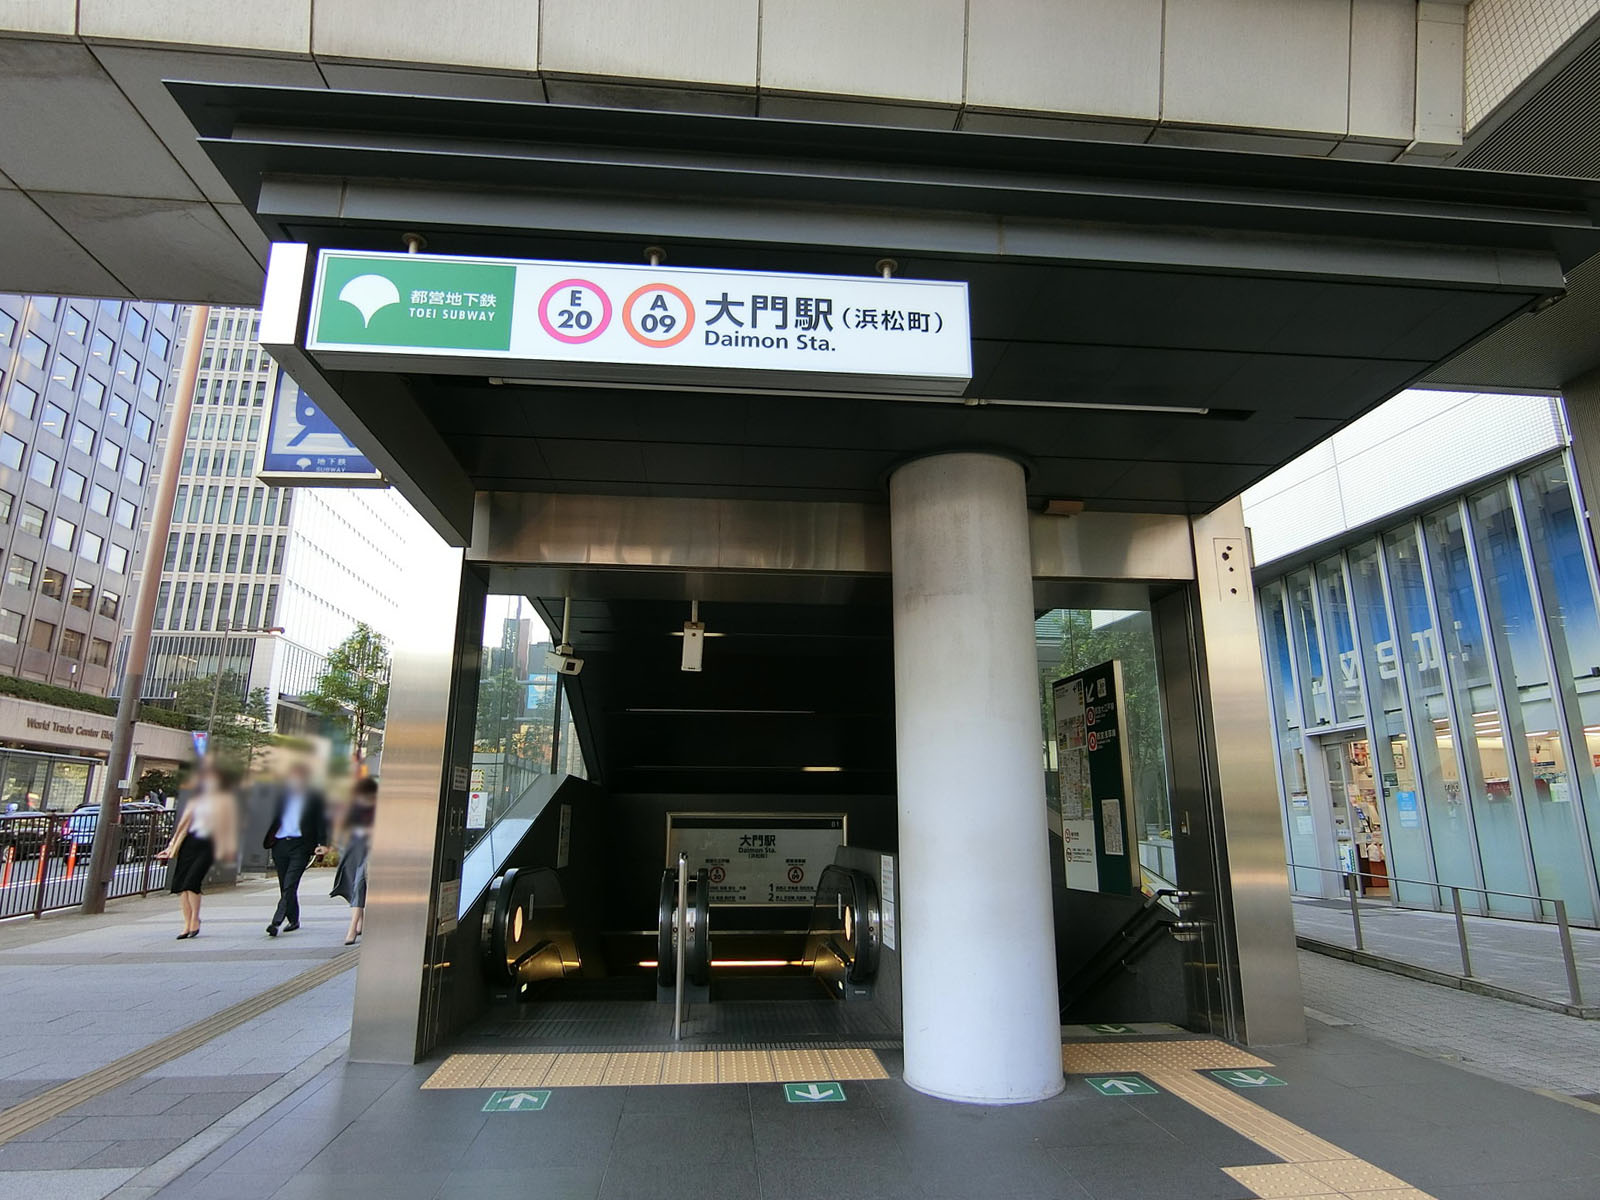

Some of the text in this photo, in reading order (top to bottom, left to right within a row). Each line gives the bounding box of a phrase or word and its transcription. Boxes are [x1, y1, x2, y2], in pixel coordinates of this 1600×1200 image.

[410, 289, 497, 309] 都営地下鉄
[571, 290, 582, 307] E
[650, 294, 668, 311] A
[409, 308, 496, 321] TOEI SUBWAY
[557, 310, 593, 330] 20
[705, 293, 943, 334] 大門駅 (浜松町)
[640, 314, 676, 334] 09
[705, 330, 836, 352] Daimon Sta.
[27, 718, 51, 731] World
[52, 722, 74, 734] Trade
[75, 726, 100, 738] Center
[739, 834, 776, 847] 大門駅
[769, 883, 774, 892] 1
[768, 893, 774, 902] 2
